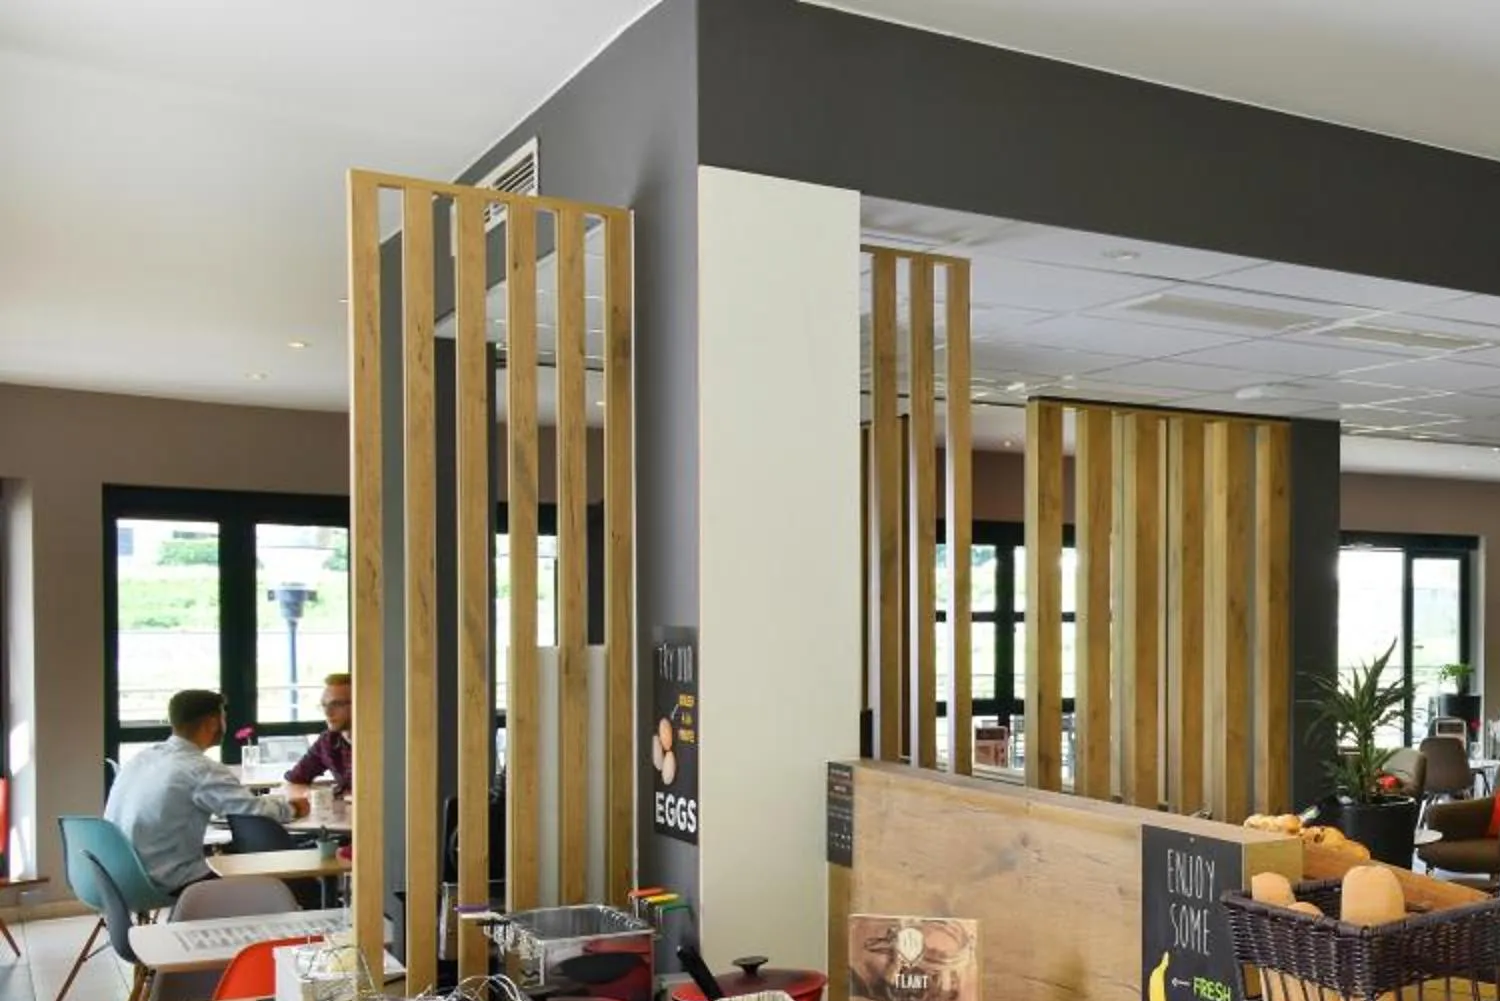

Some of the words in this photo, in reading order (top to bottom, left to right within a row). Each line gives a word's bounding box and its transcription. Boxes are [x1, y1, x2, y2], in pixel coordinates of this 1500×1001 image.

[655, 791, 697, 833] EGGS
[1166, 848, 1216, 903] ENJOY
[1169, 903, 1211, 956] SOME
